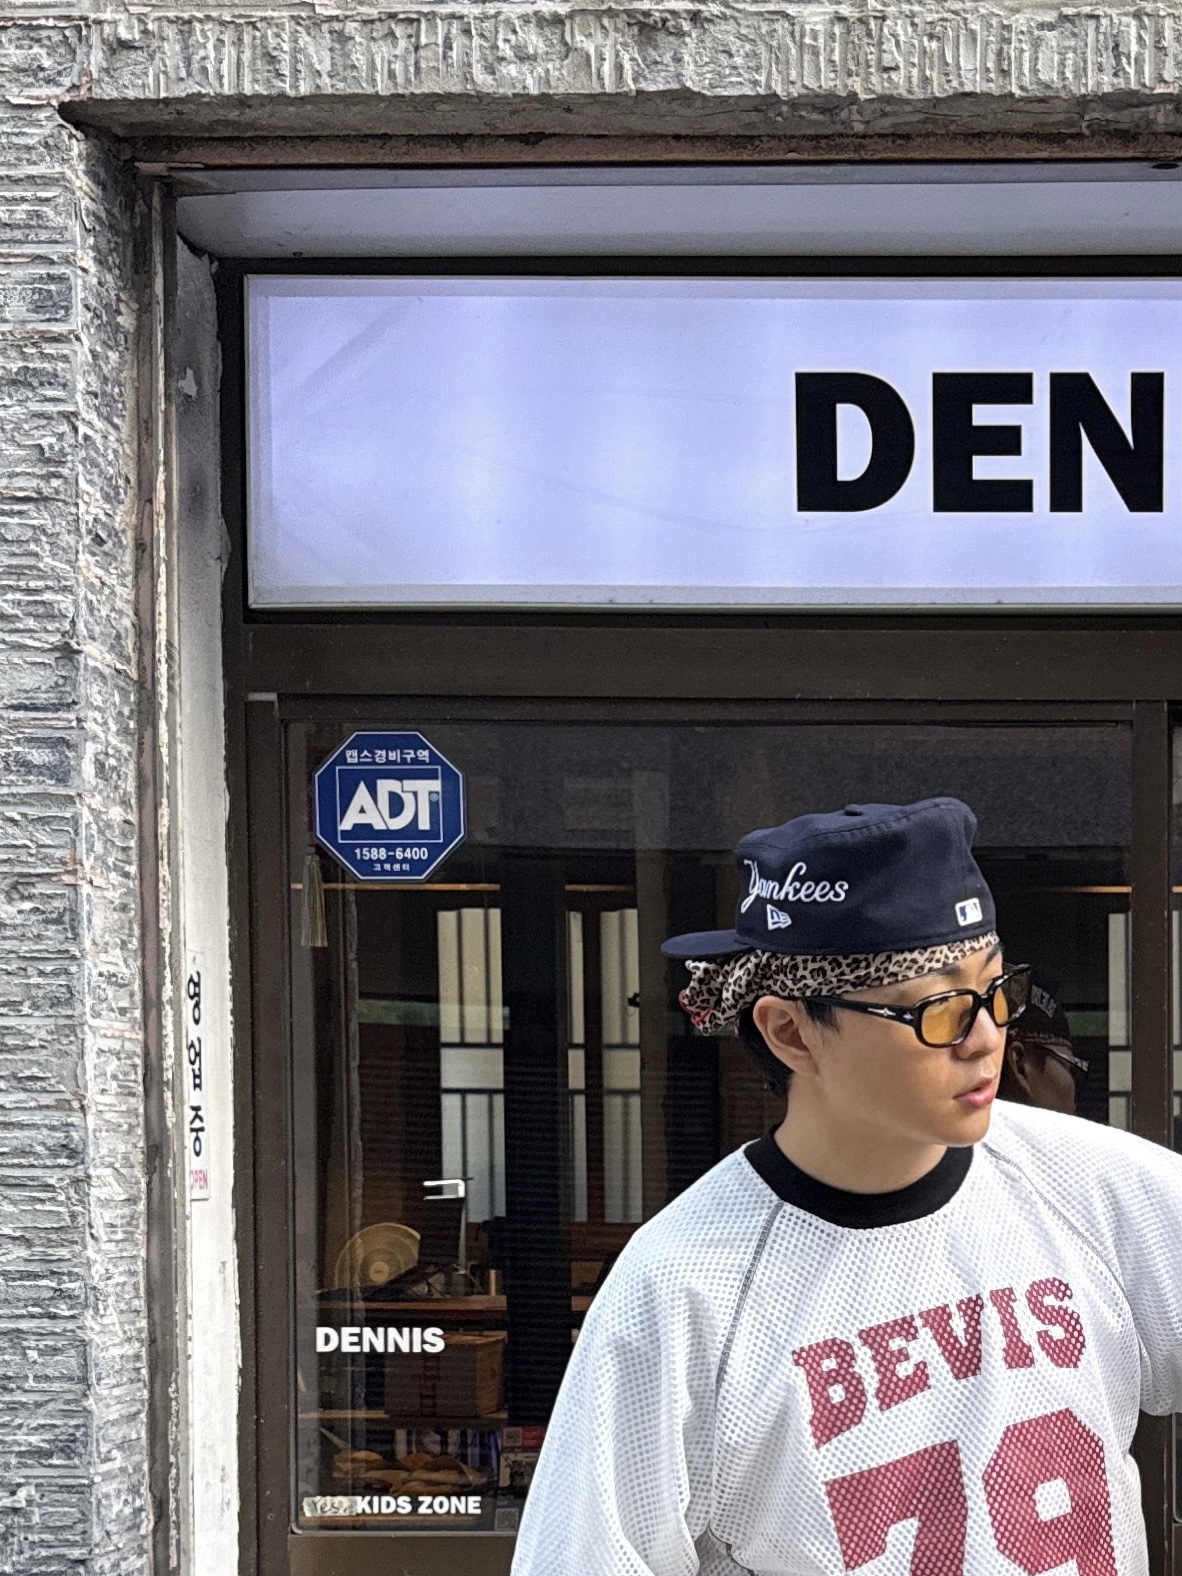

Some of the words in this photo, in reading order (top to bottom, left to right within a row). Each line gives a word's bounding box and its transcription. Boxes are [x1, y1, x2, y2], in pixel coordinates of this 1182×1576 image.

[345, 749, 430, 763] 캡스경비구역
[339, 779, 441, 831] ADT
[354, 847, 429, 861] 1588-6400
[742, 858, 849, 914] Yankees
[187, 970, 206, 1157] 영업중
[315, 1326, 446, 1354] DENNIS
[791, 1276, 1087, 1451] BEVIS
[355, 1495, 413, 1515] KIDS
[418, 1495, 482, 1515] ZONE
